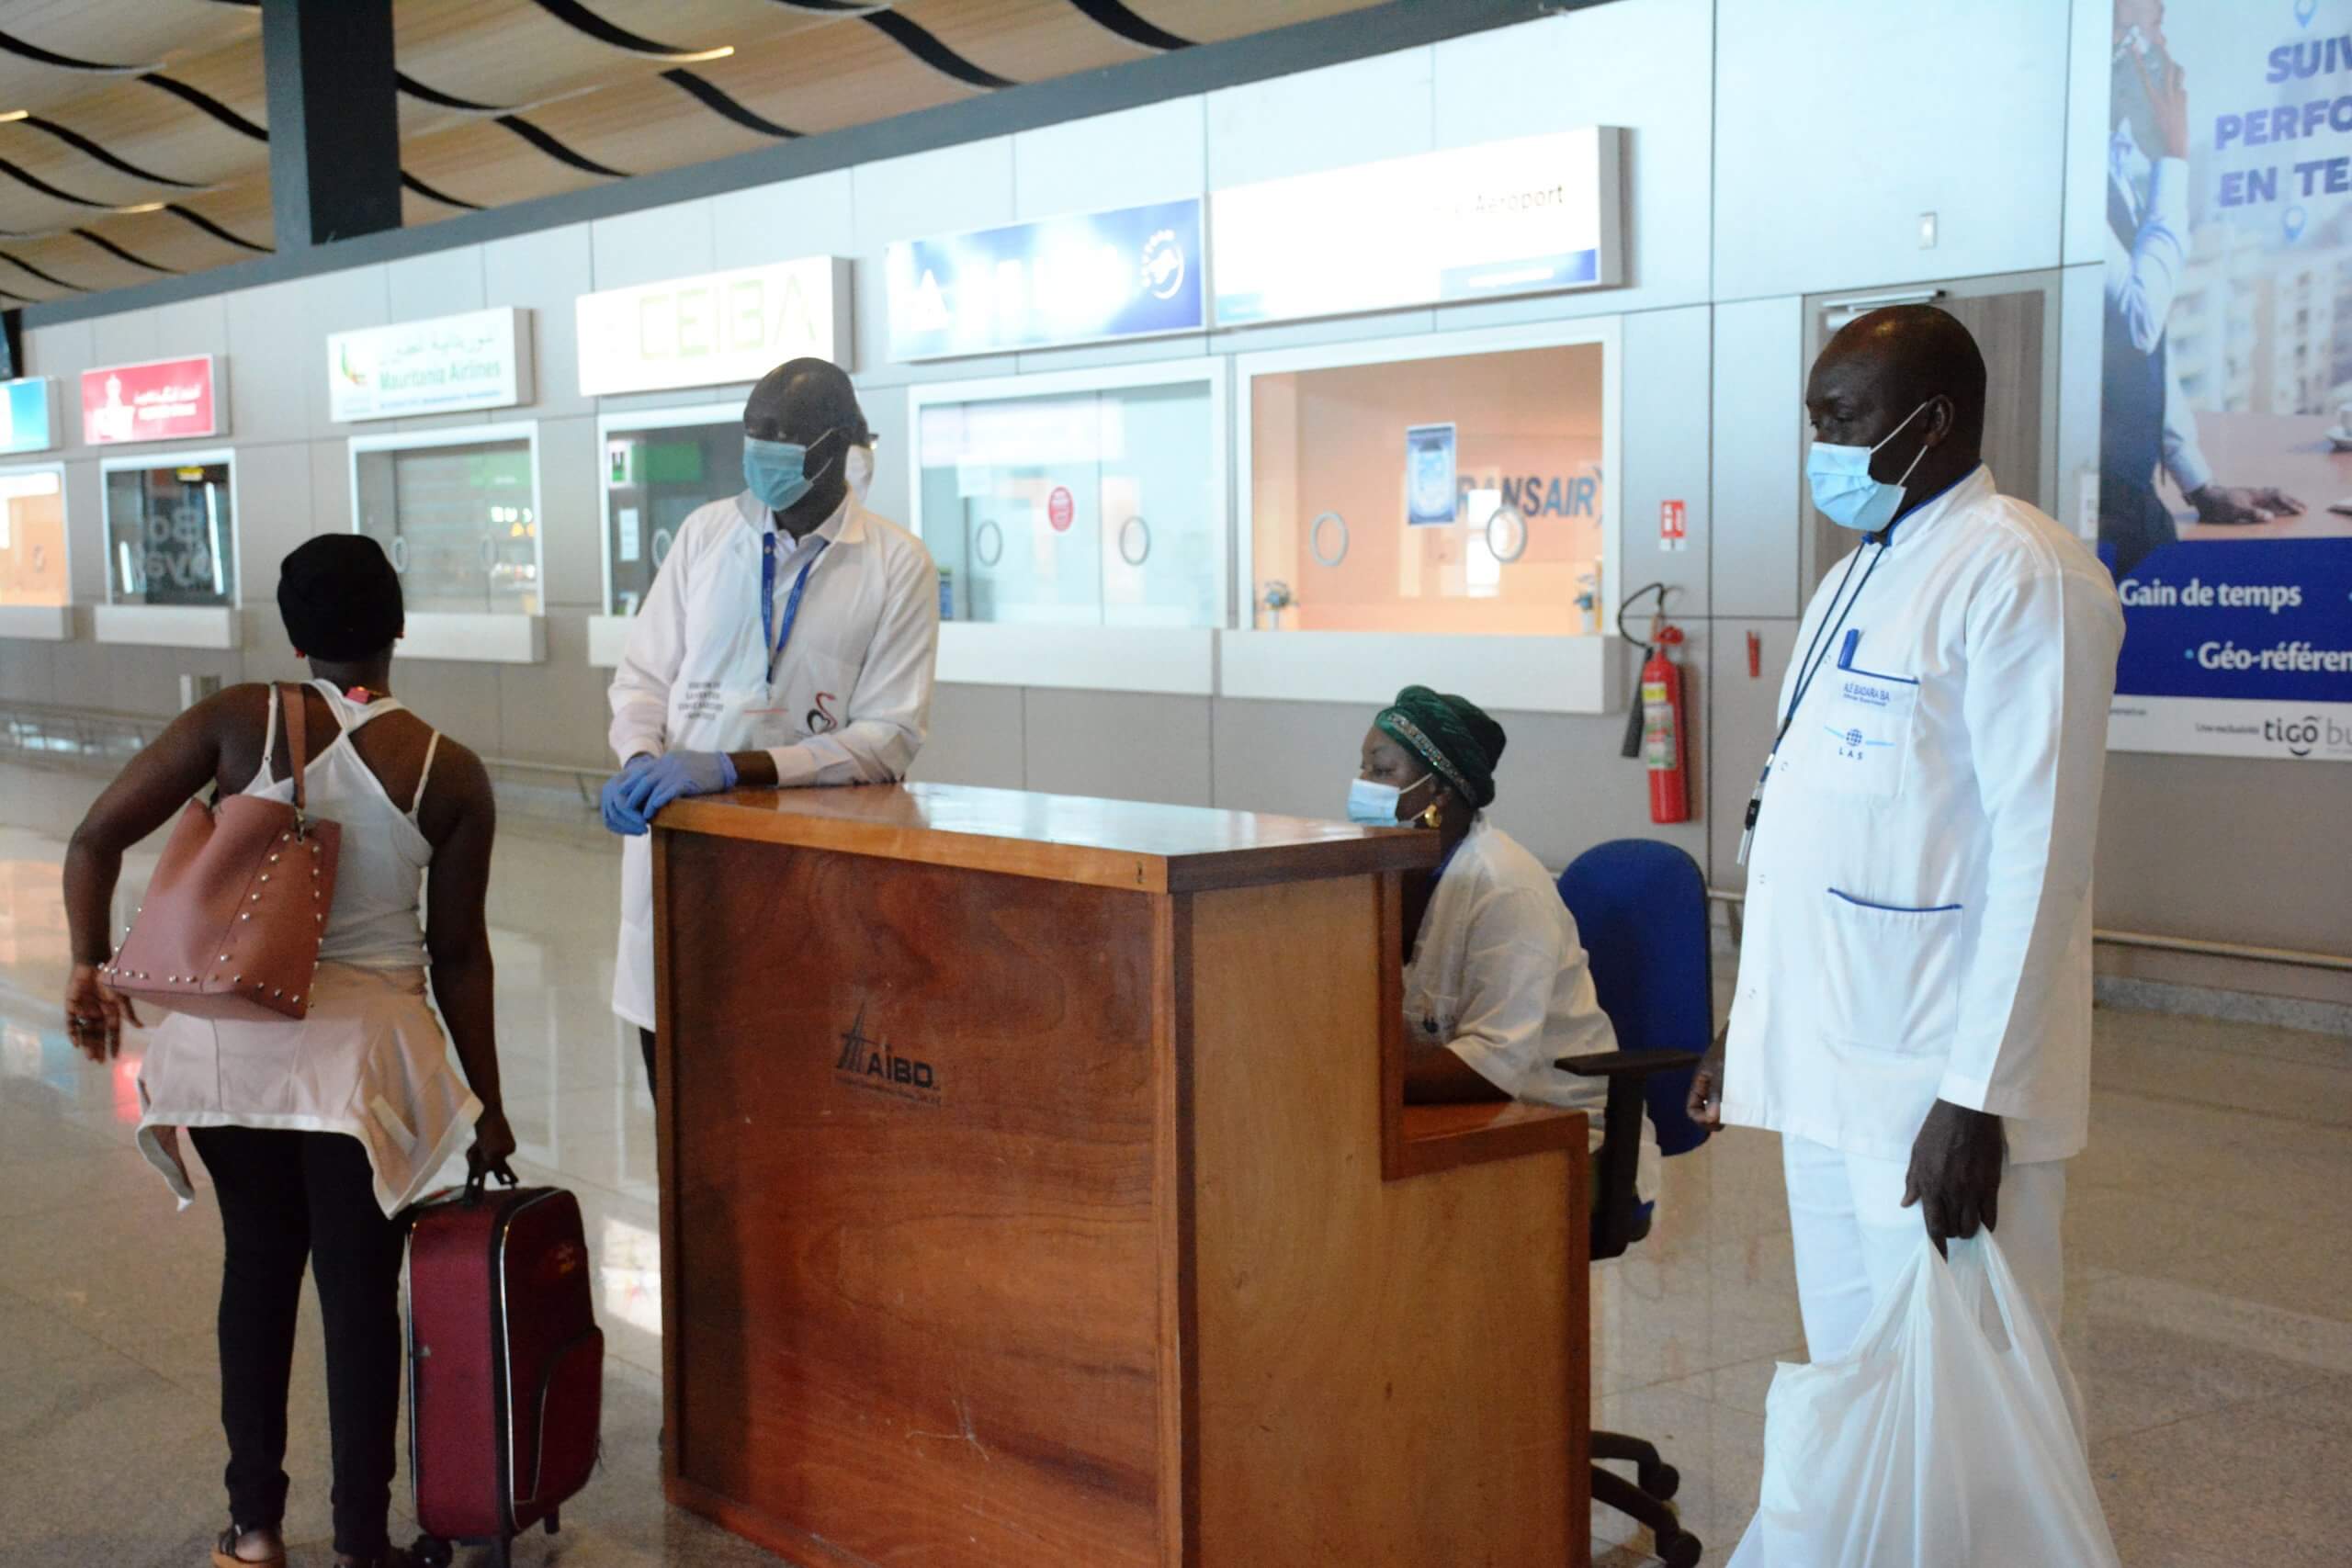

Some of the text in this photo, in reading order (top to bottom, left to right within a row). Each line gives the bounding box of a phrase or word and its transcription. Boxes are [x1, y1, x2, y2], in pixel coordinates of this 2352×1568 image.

[2214, 95, 2352, 151] PERFO
[2219, 156, 2351, 208] EN TE
[2118, 578, 2302, 615] Gain de temps
[2197, 640, 2352, 671] Géo-référen
[1838, 747, 1863, 761] LAS
